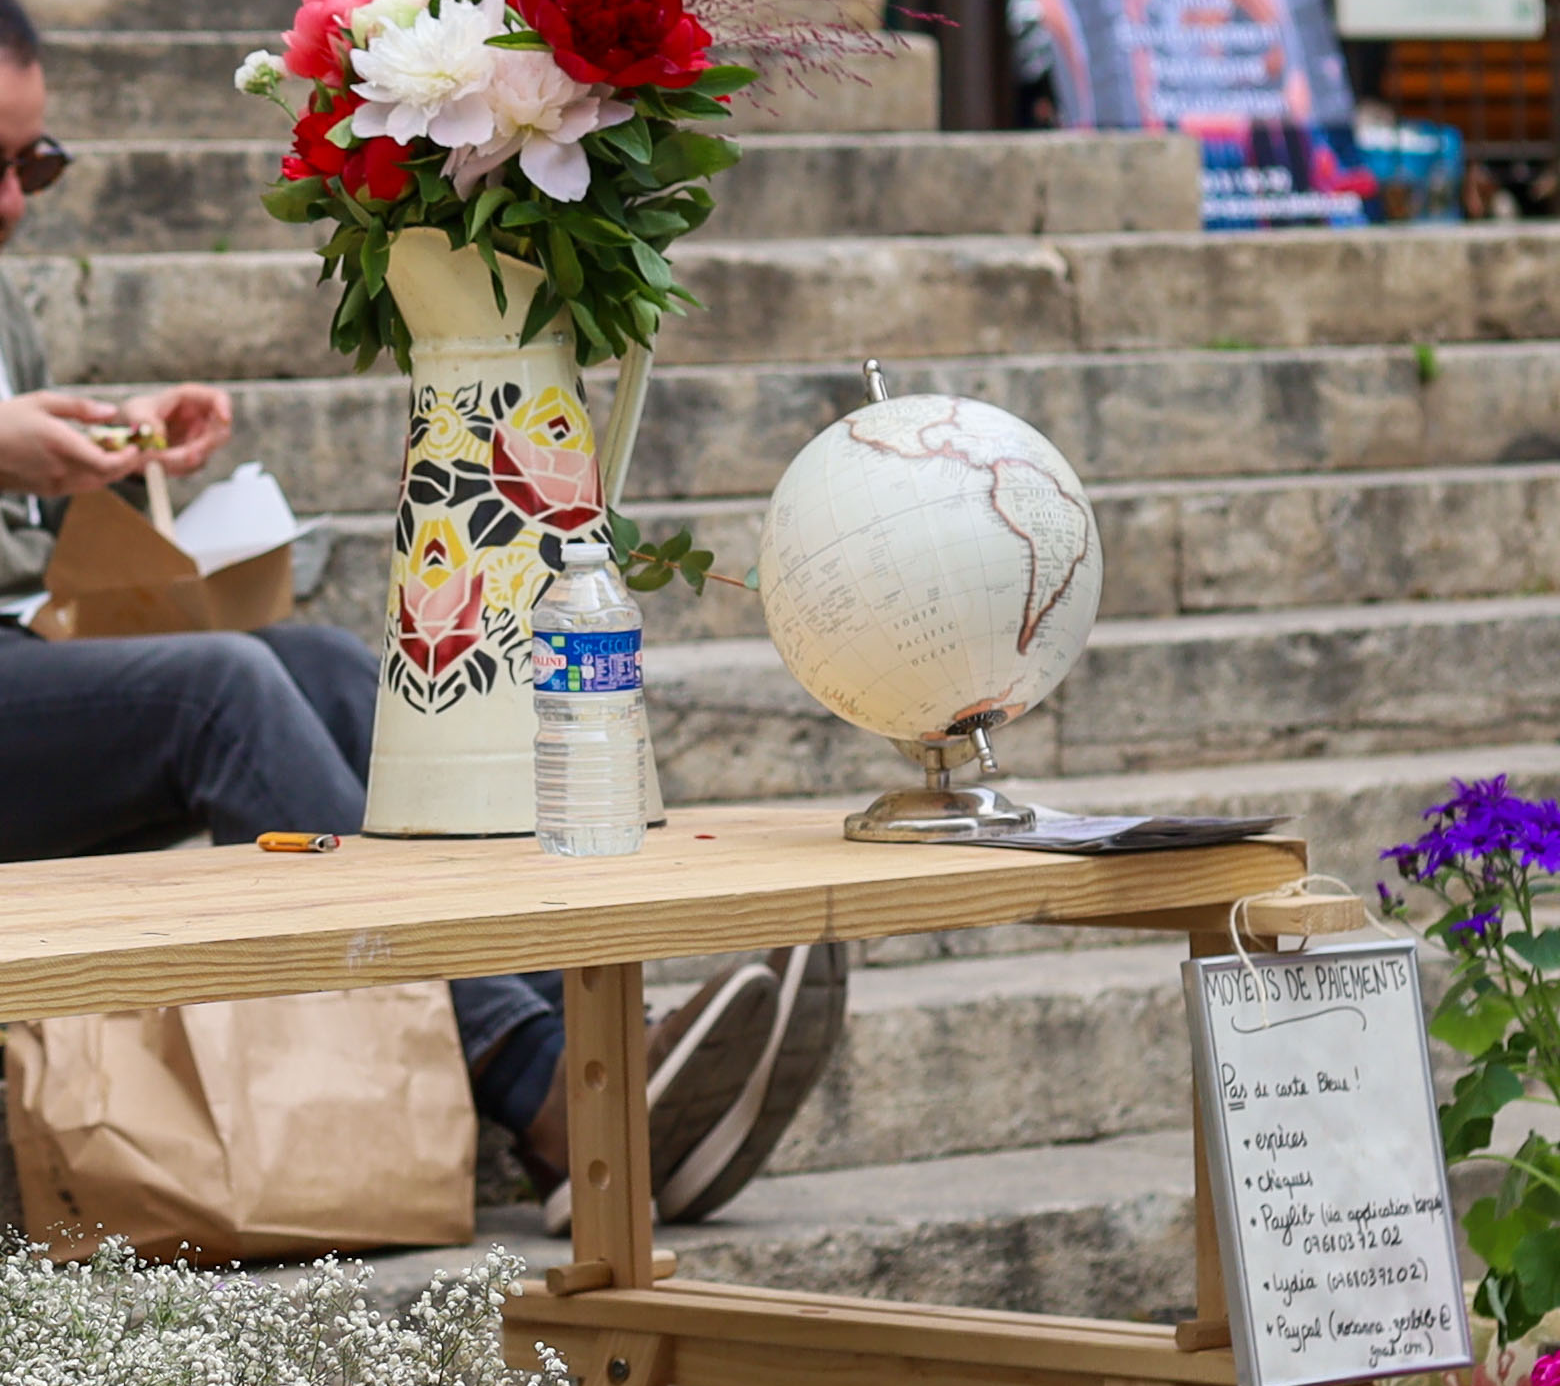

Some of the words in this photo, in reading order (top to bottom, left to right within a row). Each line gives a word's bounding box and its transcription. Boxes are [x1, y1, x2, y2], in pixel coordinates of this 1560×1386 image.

[911, 642, 957, 667] OCEAN
[1284, 966, 1311, 1001] DE
[1221, 1063, 1247, 1099] Pas
[1254, 1081, 1269, 1098] de
[1276, 1075, 1309, 1098] carte
[1273, 1269, 1317, 1306] Lydia
